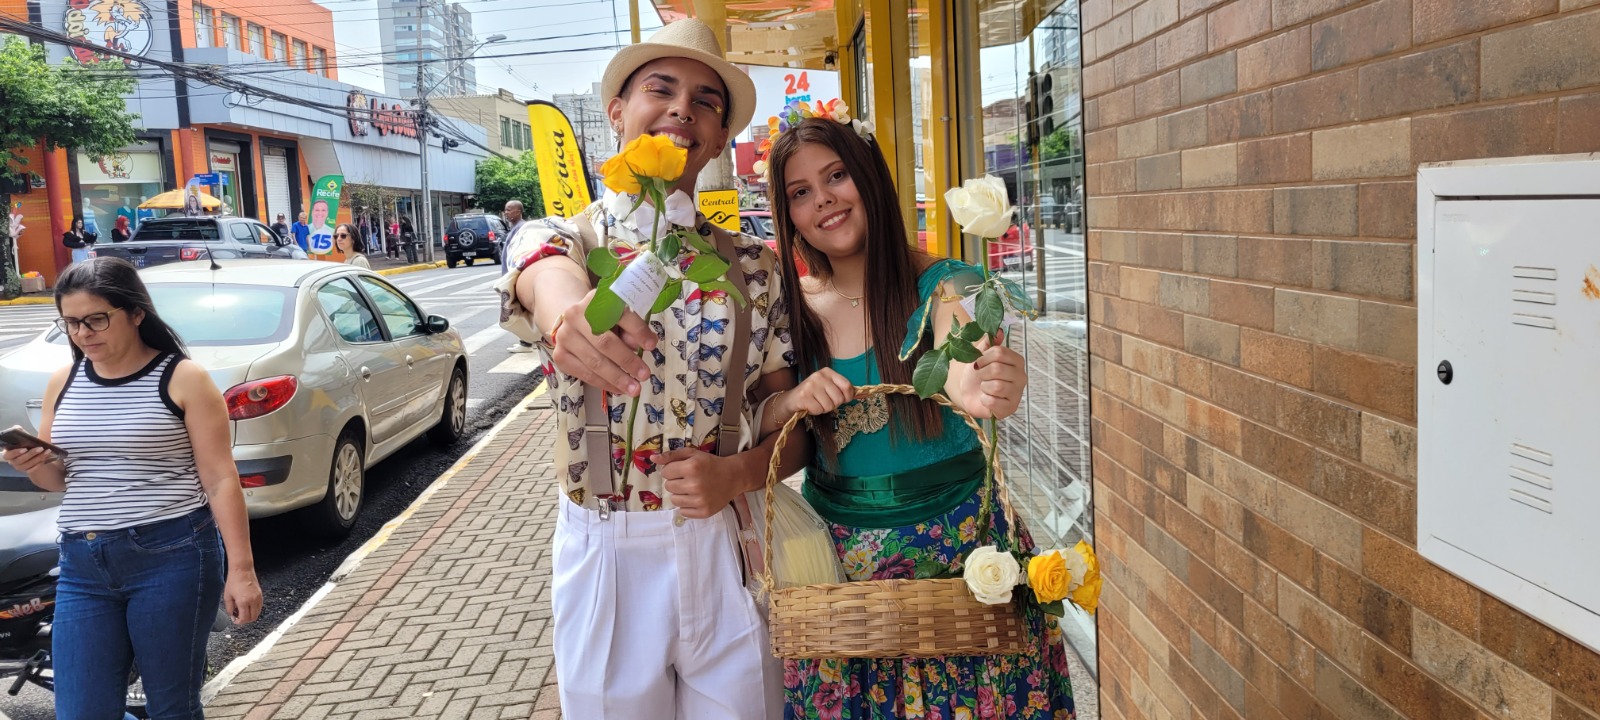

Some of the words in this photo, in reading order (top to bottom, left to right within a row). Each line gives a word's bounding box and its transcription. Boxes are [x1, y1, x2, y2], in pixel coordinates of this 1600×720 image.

[784, 71, 810, 95] 24
[316, 189, 340, 198] Recife
[701, 196, 736, 207] Central
[311, 233, 332, 250] 15
